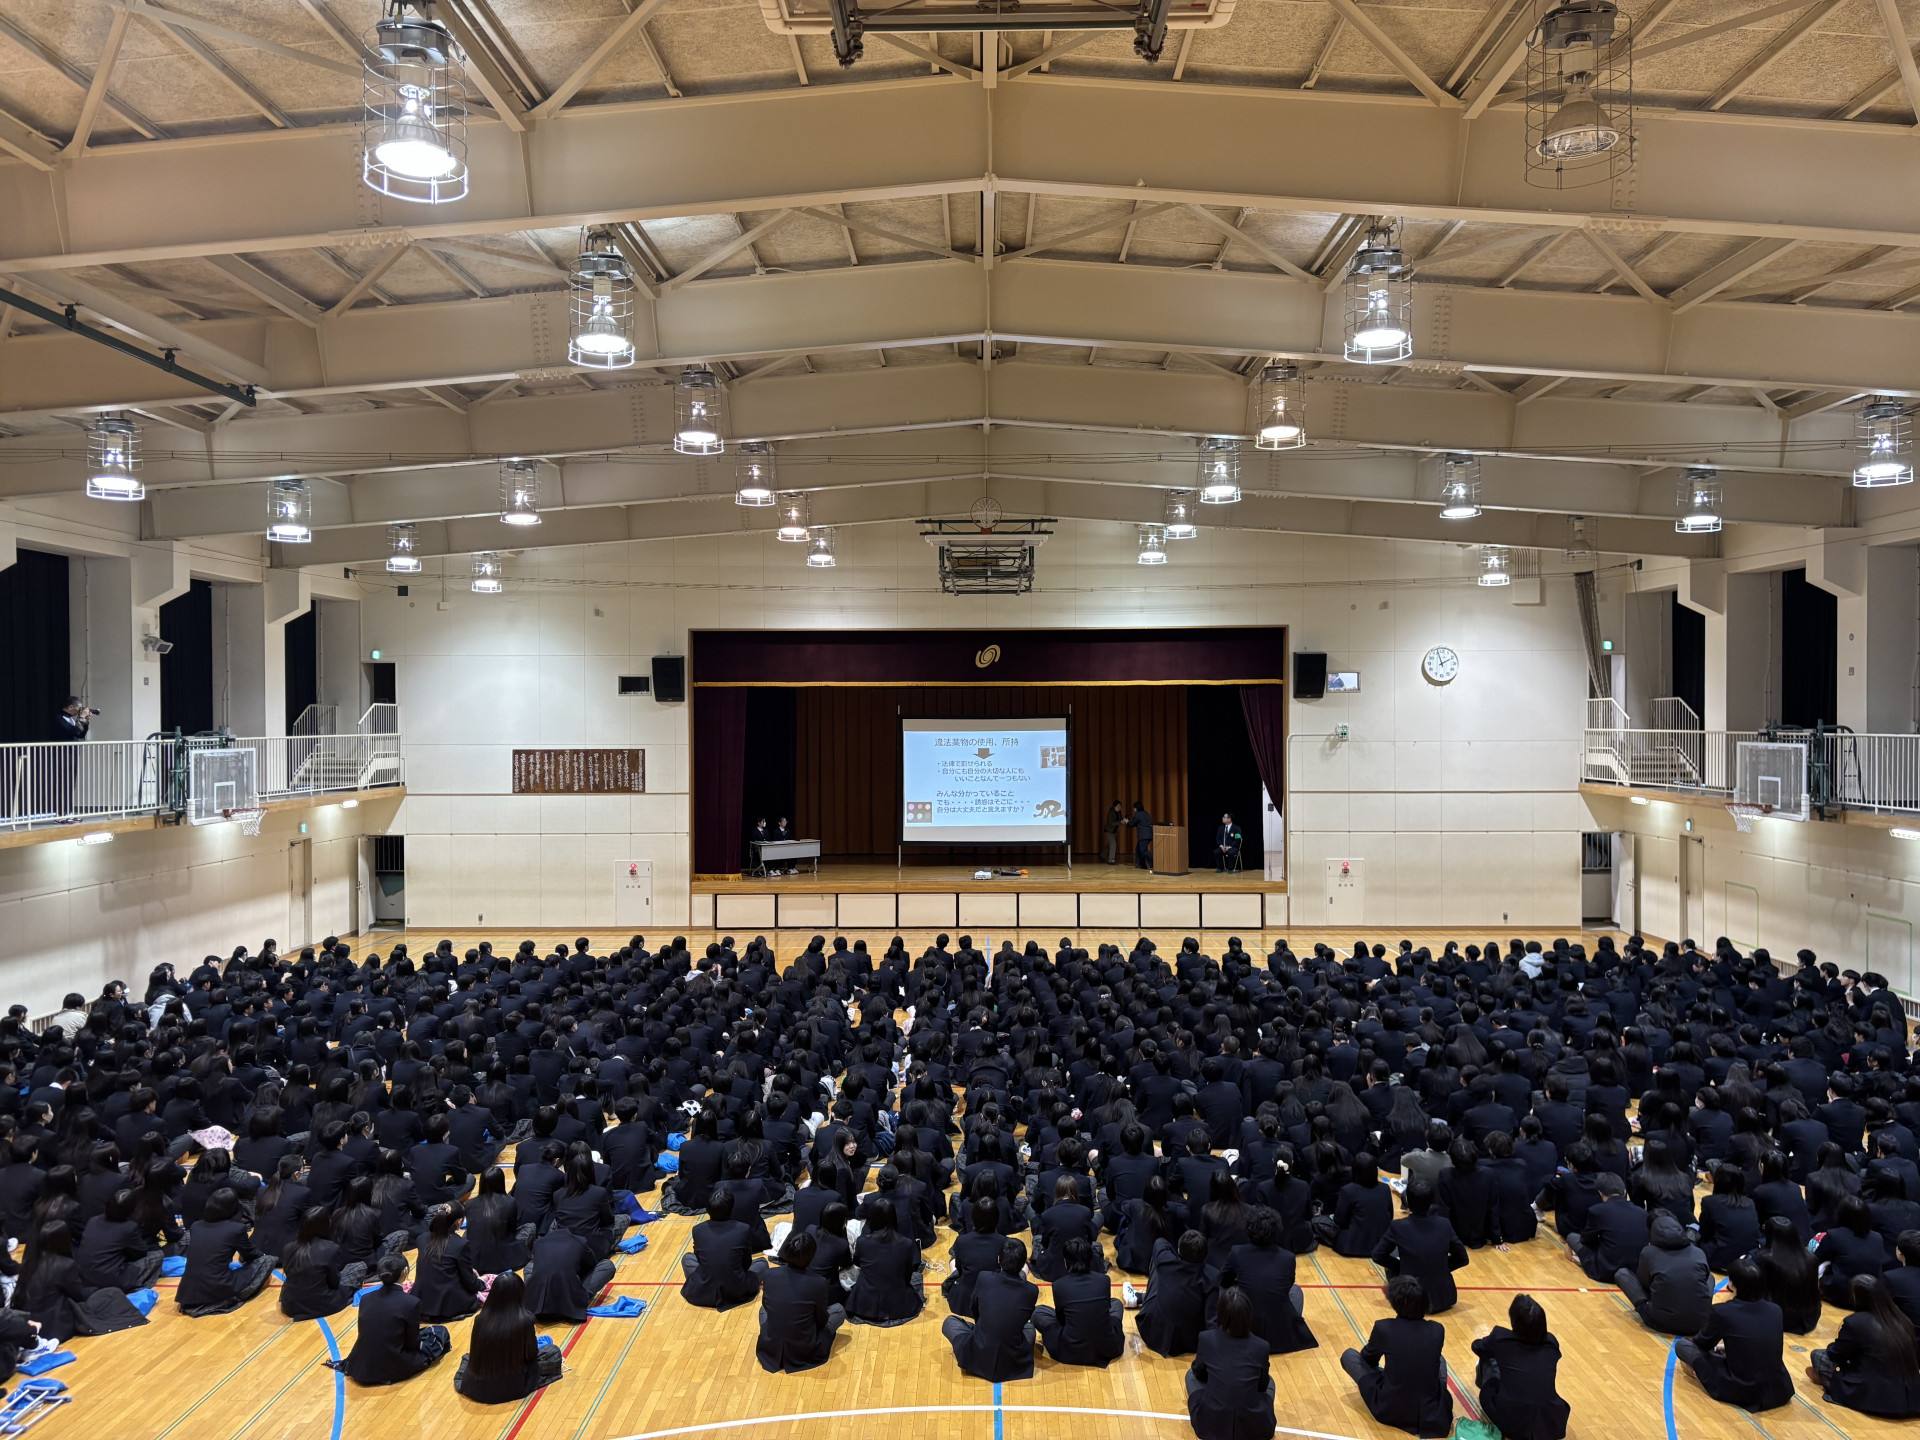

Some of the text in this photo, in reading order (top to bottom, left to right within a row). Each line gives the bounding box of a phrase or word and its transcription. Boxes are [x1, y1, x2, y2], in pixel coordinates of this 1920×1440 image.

[934, 738, 1019, 746] 違法薬物の使用、所持
